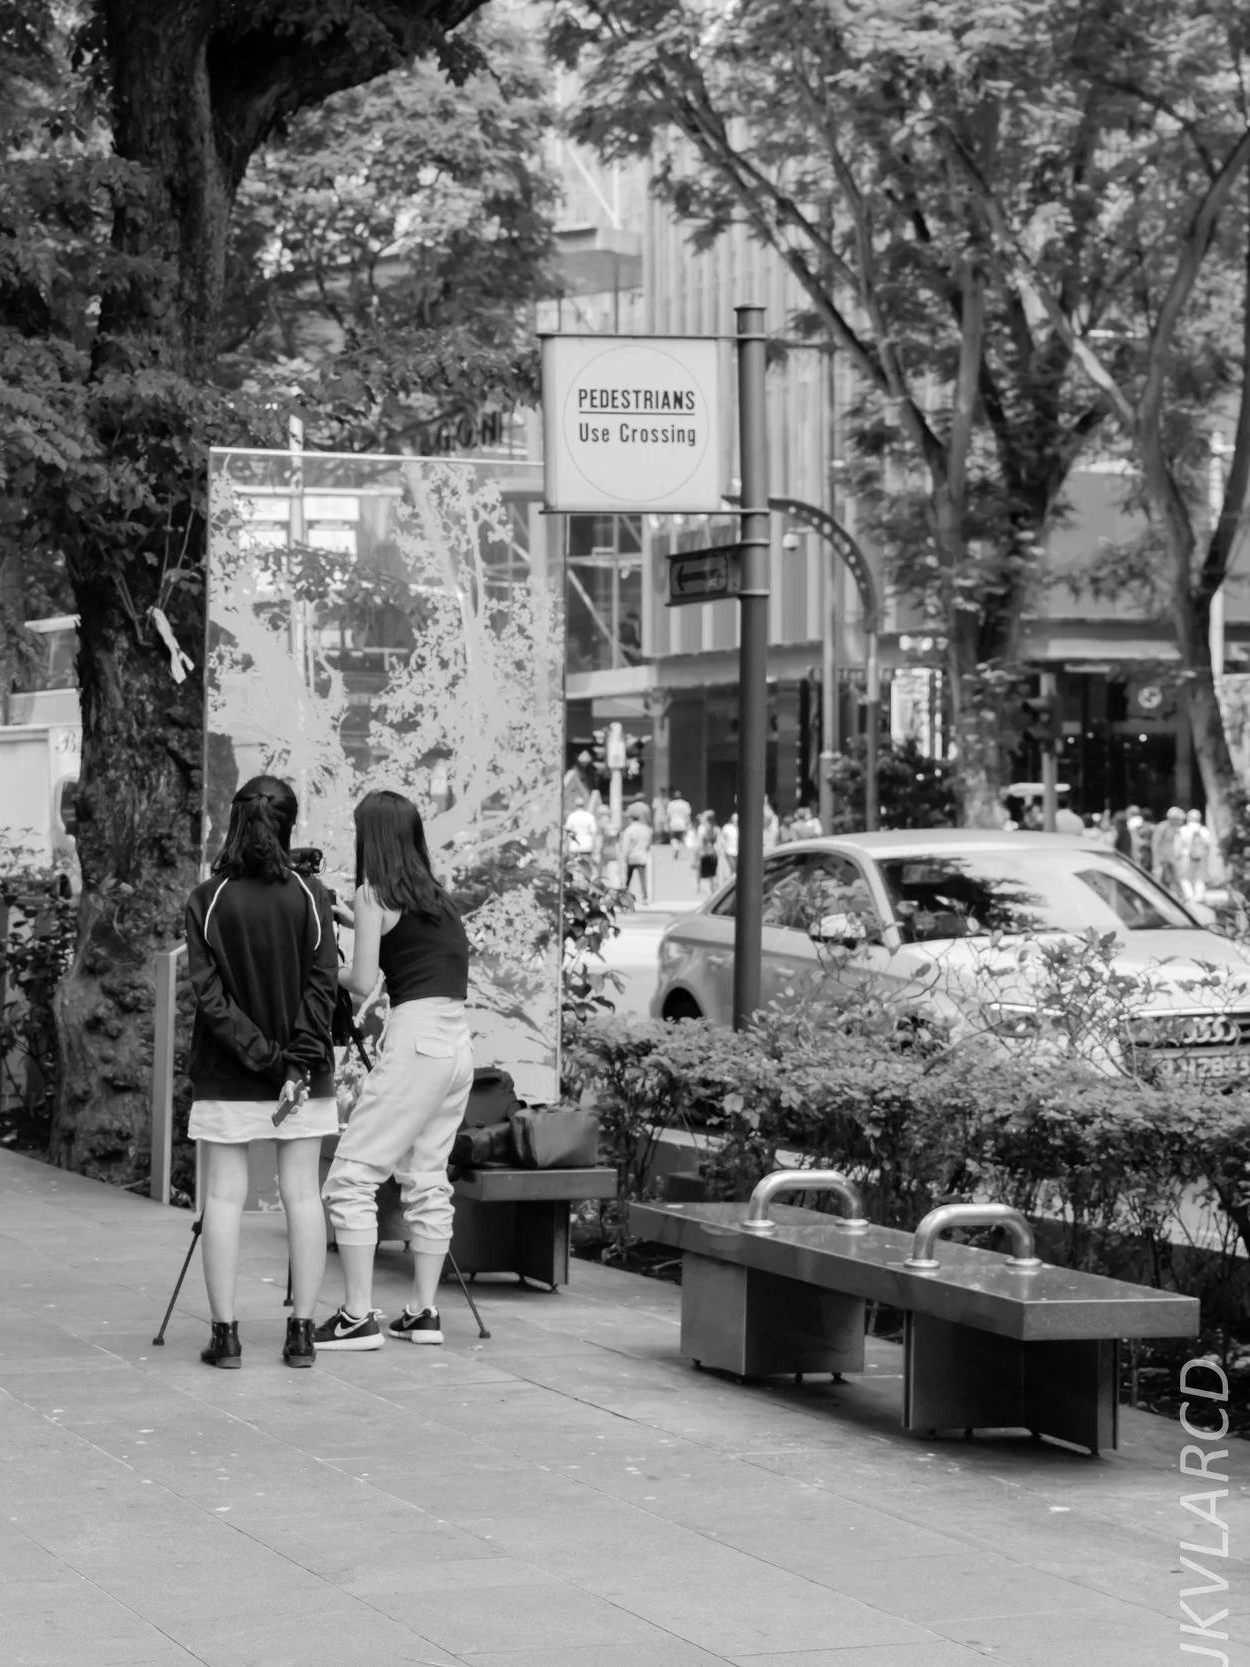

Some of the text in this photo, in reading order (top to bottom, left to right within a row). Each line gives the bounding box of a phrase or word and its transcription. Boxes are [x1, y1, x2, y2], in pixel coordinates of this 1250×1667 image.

[578, 389, 695, 410] PEDESTRIANS
[579, 422, 696, 447] Use Crossing
